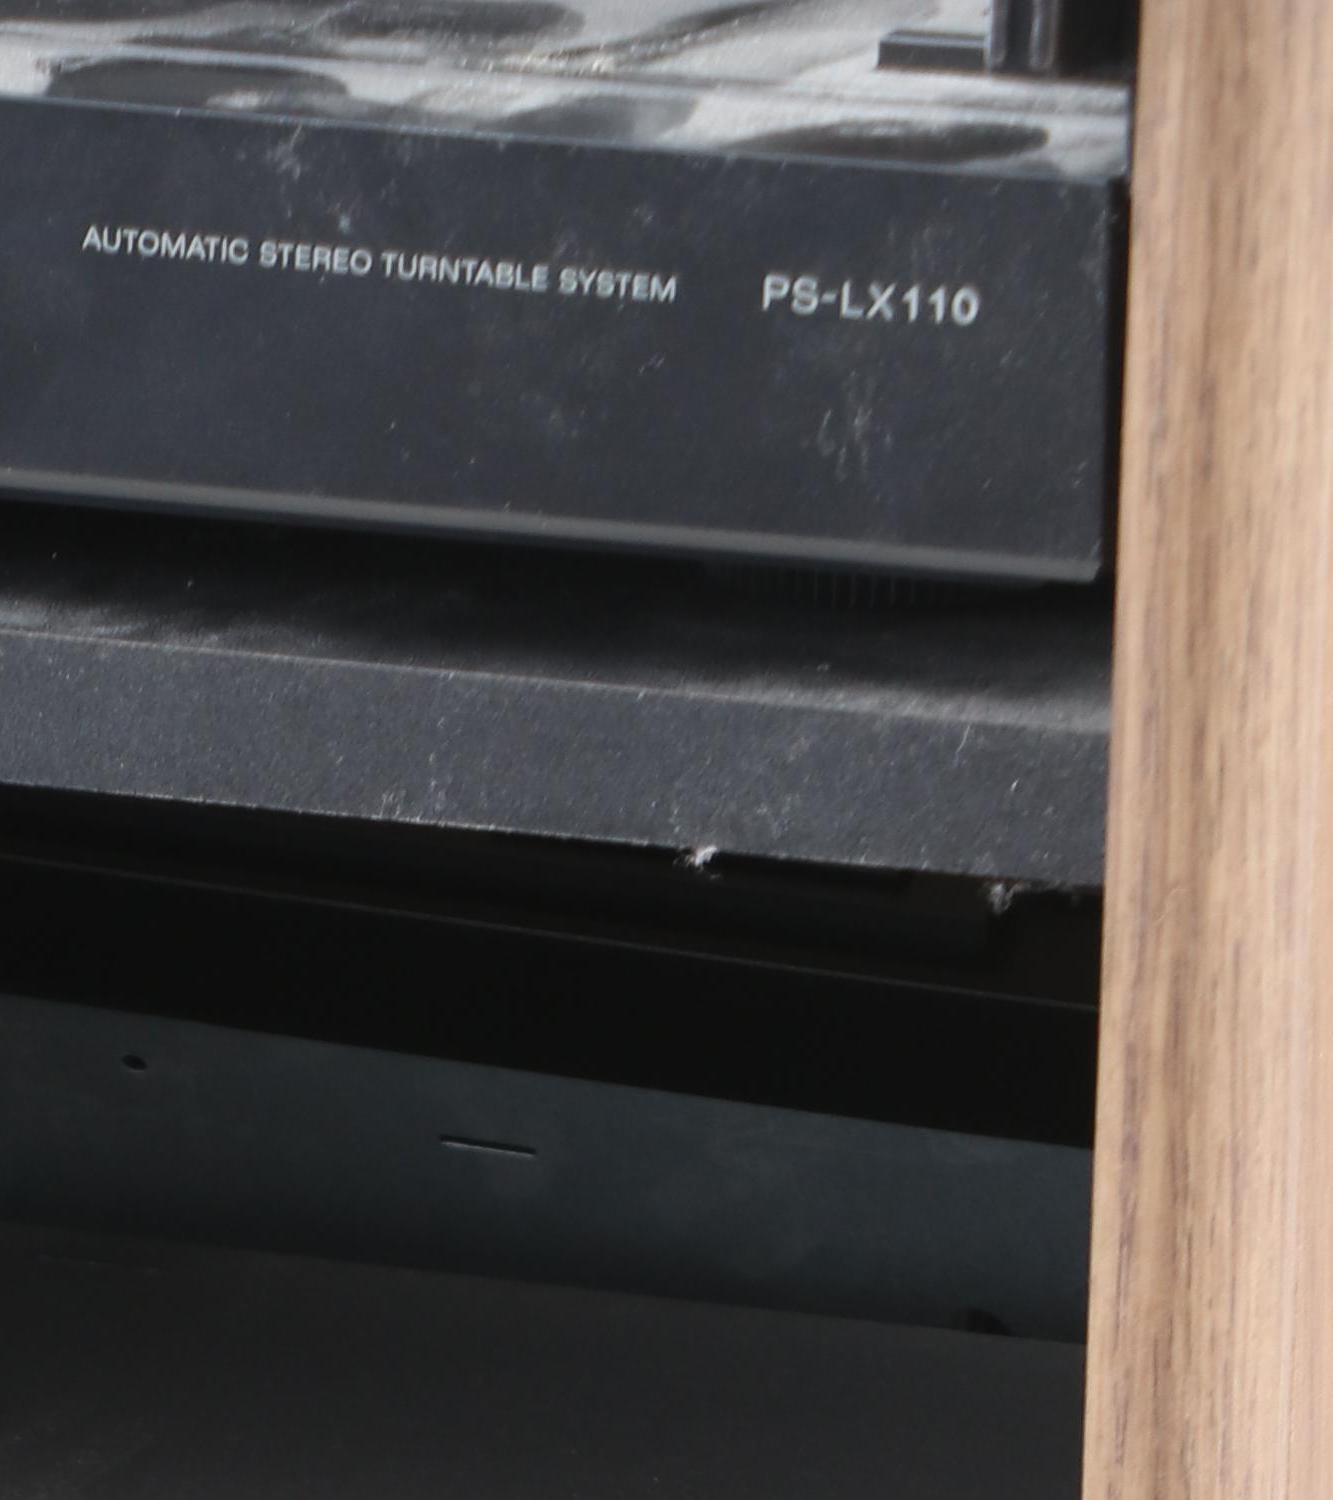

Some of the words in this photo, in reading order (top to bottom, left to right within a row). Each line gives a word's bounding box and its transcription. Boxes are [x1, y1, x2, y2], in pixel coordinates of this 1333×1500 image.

[82, 224, 249, 264] AUTOMATIC
[260, 240, 372, 275] STEREO
[381, 251, 548, 293] TURNTABLE
[559, 265, 677, 303] SYSTEM
[762, 272, 981, 327] PS-LX110
